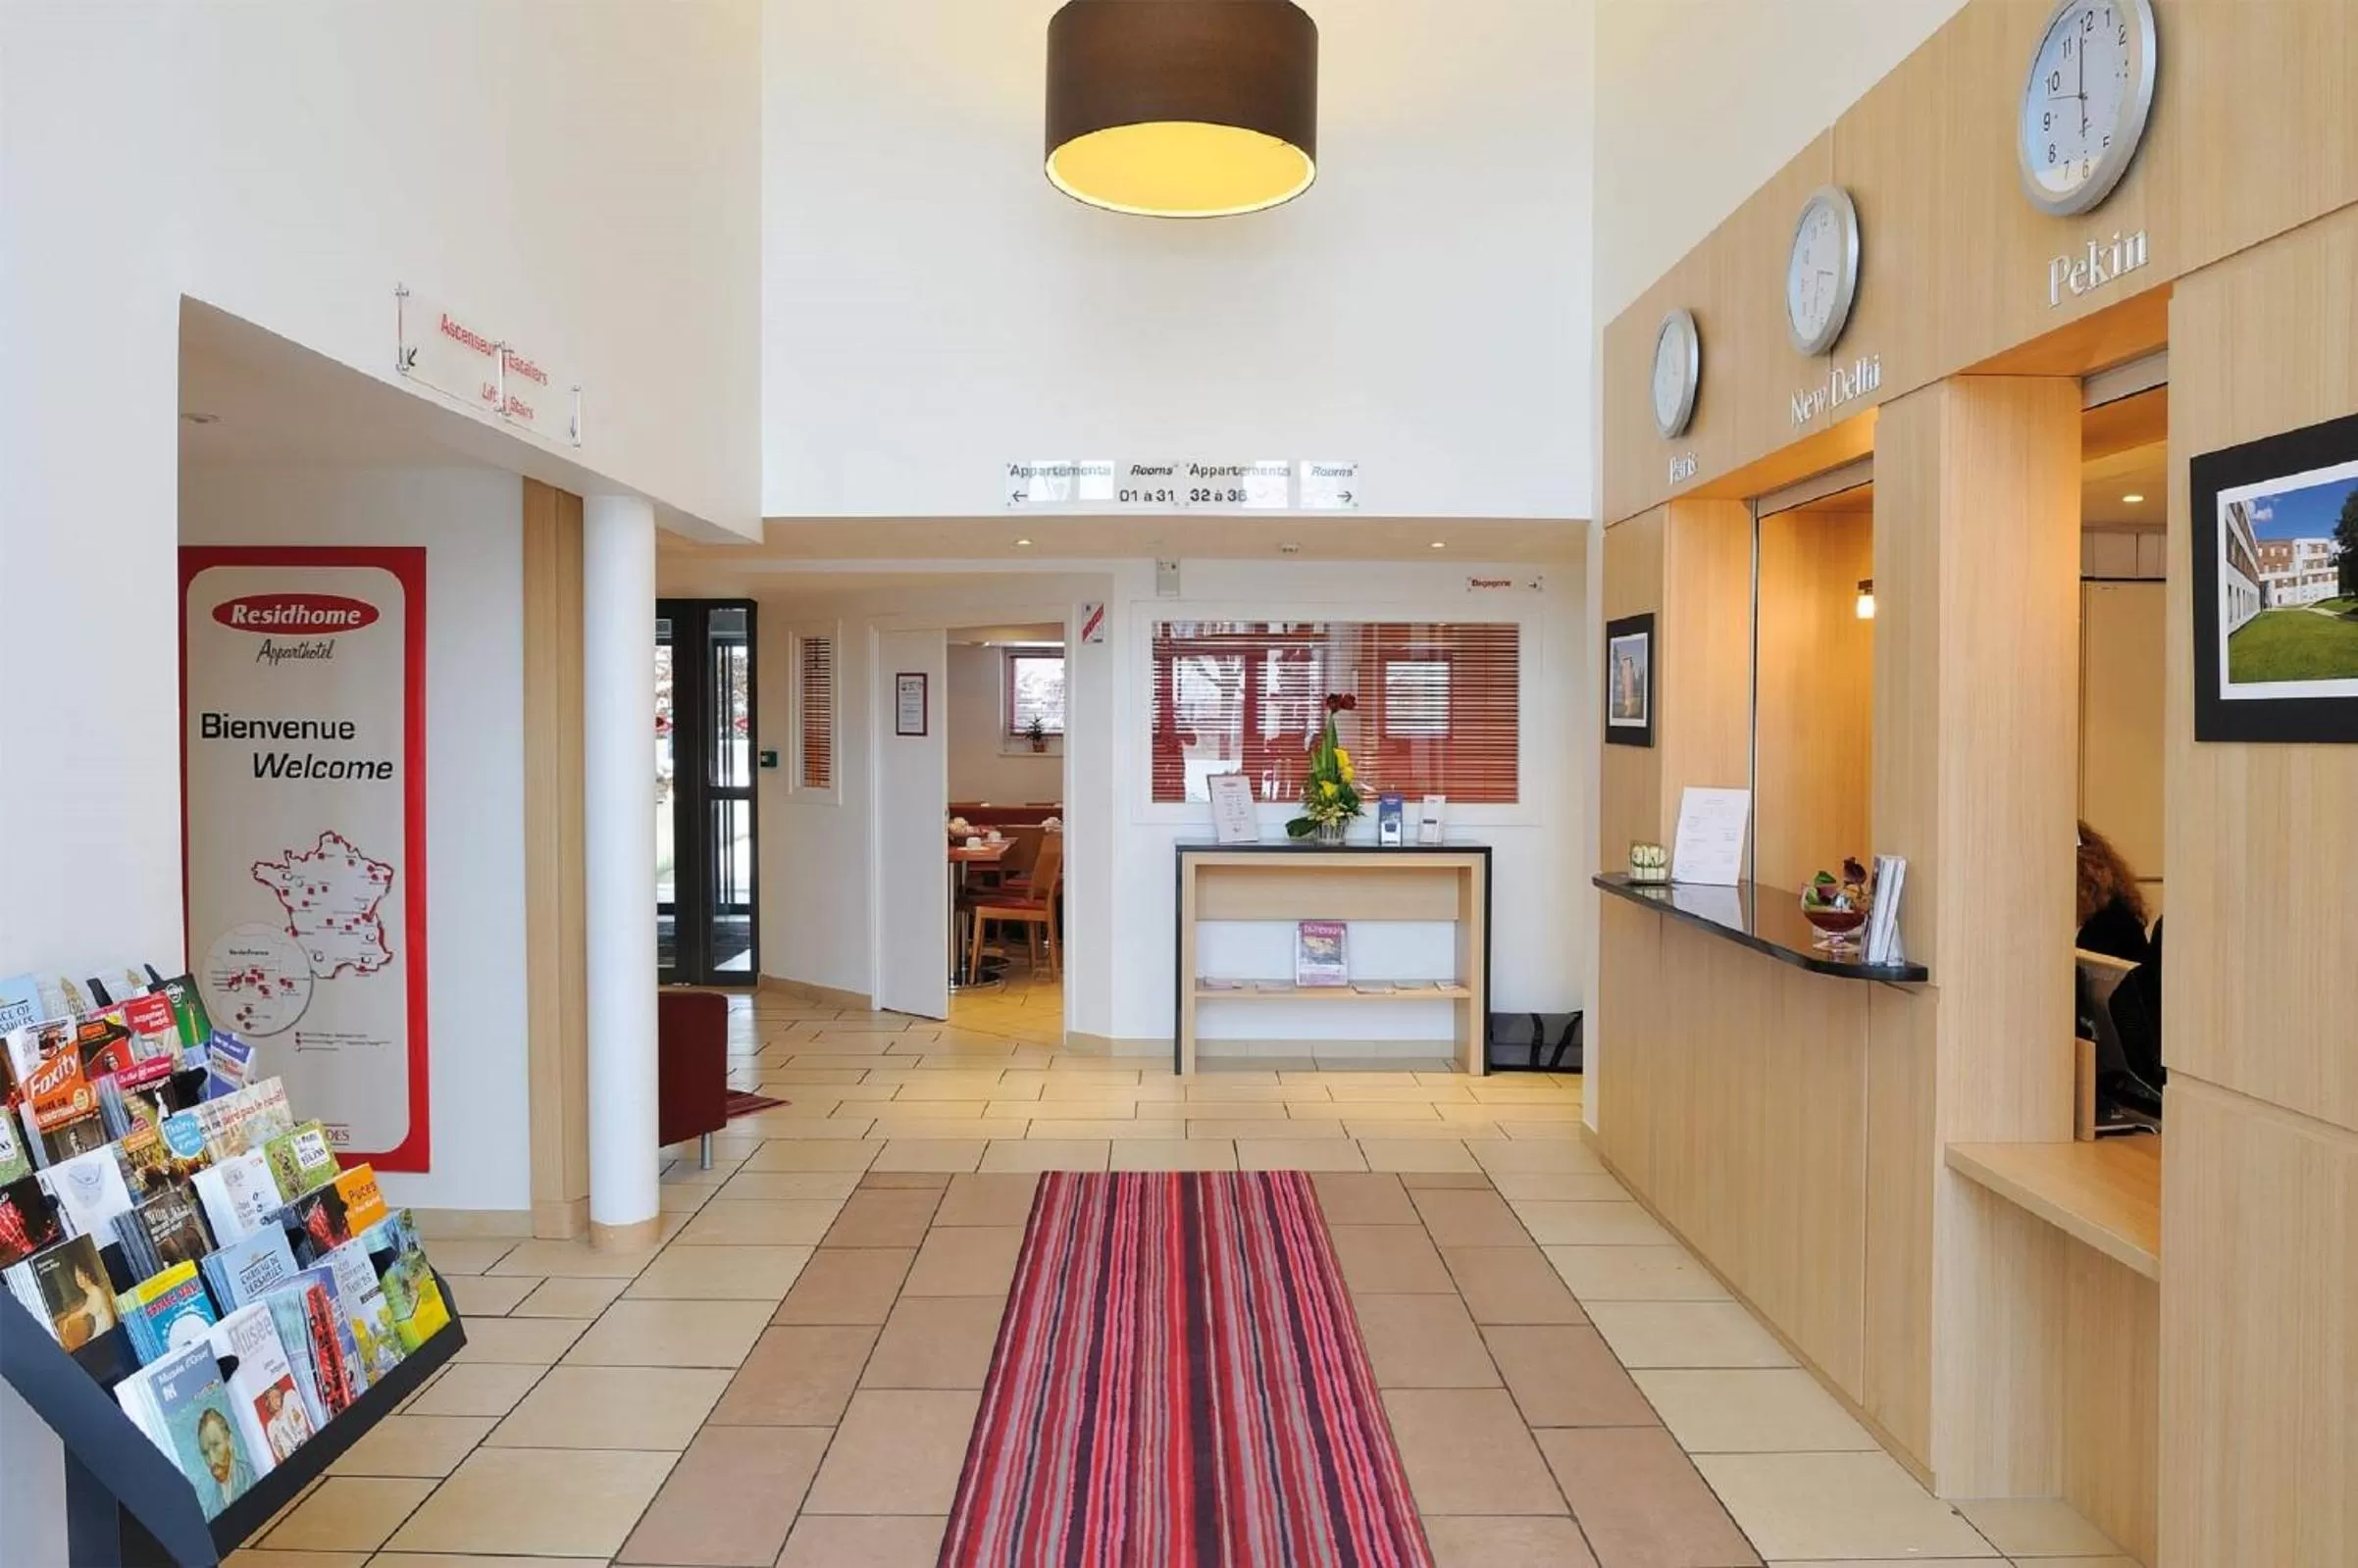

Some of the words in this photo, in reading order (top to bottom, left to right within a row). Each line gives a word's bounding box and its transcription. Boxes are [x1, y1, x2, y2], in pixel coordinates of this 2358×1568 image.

[2080, 11, 2094, 32] 12
[2063, 35, 2072, 59] 11
[2045, 71, 2060, 95] 10
[2043, 112, 2051, 131] 9
[2048, 143, 2056, 164] 8
[2063, 160, 2071, 180] 7
[2048, 228, 2149, 307] Pekin
[1791, 382, 1830, 429] New
[1829, 352, 1882, 410] Delhi
[1130, 464, 1173, 476] Rooms
[1311, 466, 1354, 478] Rooms
[1668, 451, 1699, 484] Paris
[1119, 489, 1138, 502] 01
[1155, 489, 1174, 502] 31
[1190, 489, 1210, 502] 32
[231, 604, 362, 625] Residhome
[201, 713, 355, 739] Bienvenue
[253, 752, 393, 780] Welcome
[30, 1051, 78, 1099] Foxity
[227, 1313, 274, 1353] Musée
[157, 1361, 185, 1385] Musée
